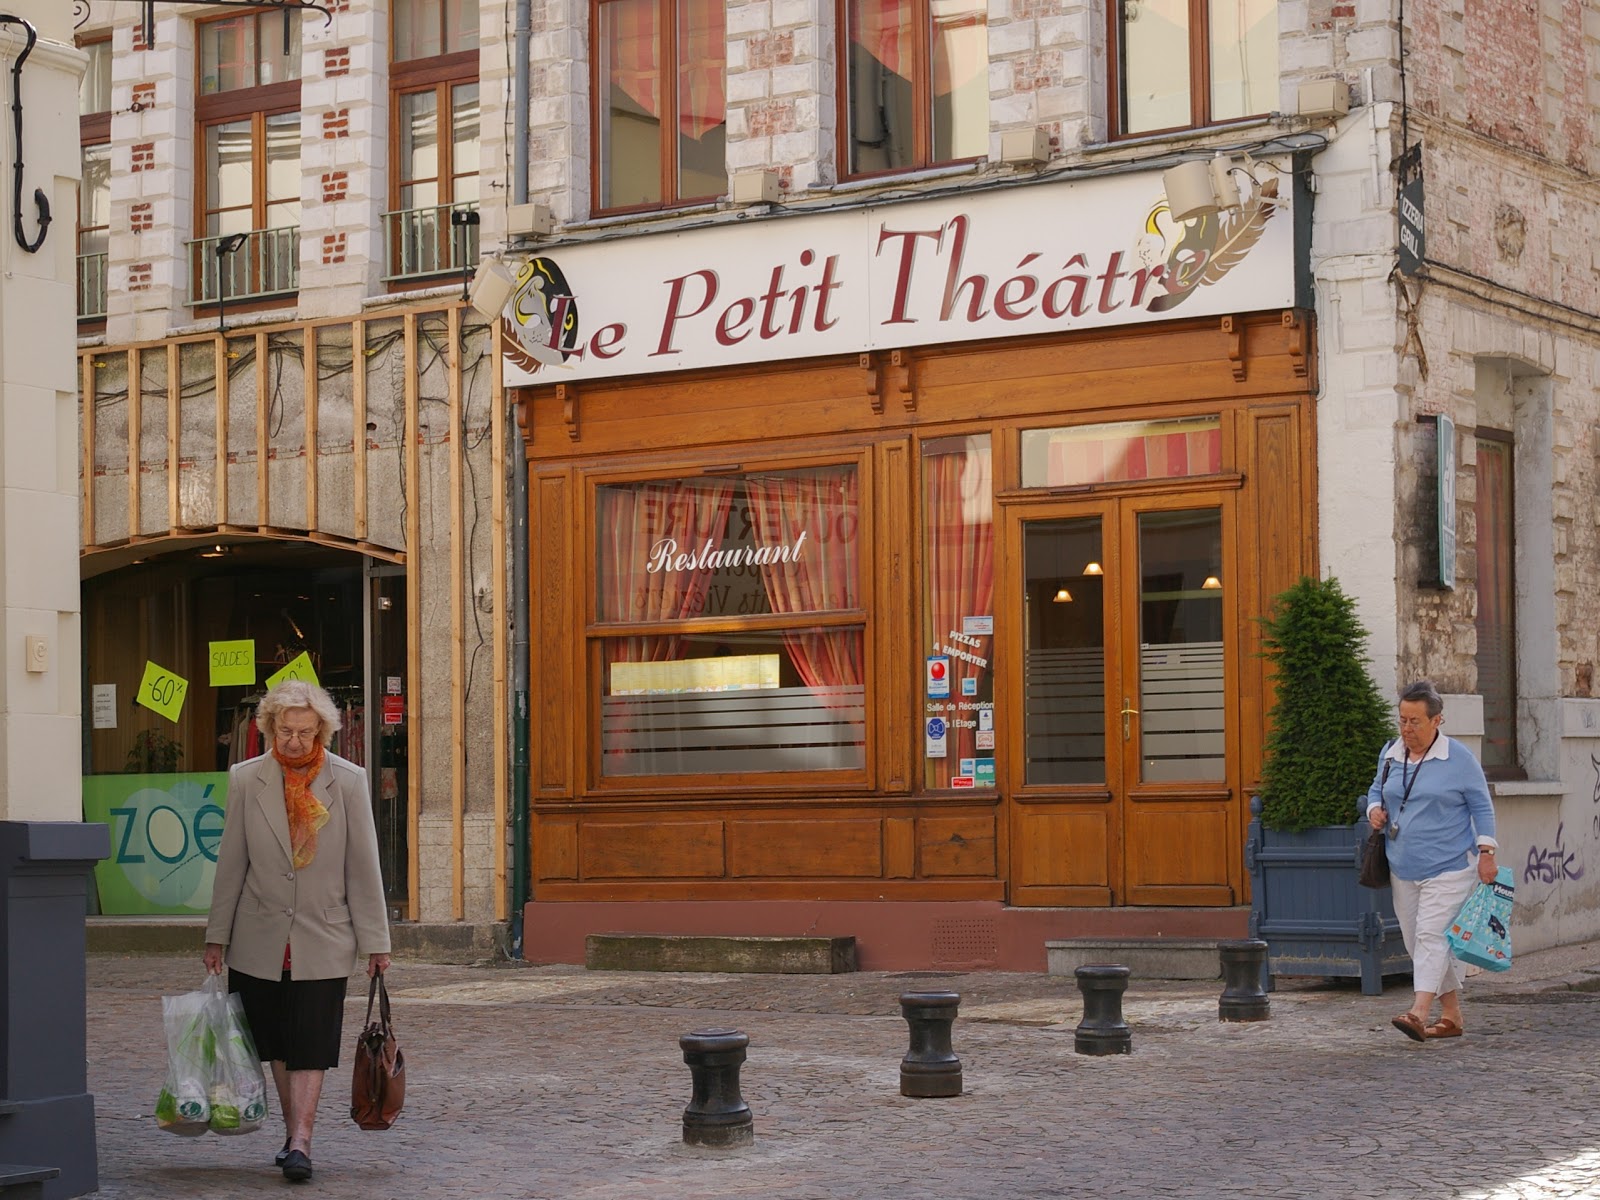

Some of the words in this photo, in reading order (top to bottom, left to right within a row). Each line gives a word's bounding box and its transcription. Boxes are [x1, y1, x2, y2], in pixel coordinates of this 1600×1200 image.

[1400, 193, 1424, 235] IZZERIA
[1400, 224, 1419, 260] GRILL
[543, 294, 628, 362] Le
[648, 249, 844, 358] Petit
[876, 214, 1210, 324] Théâtre
[646, 530, 807, 574] Restaurant
[949, 630, 982, 649] PIZZAS
[211, 651, 250, 667] SOLDES
[942, 645, 988, 669] EMPORTER
[926, 702, 944, 712] Salle
[946, 702, 956, 711] de
[958, 701, 994, 711] Réception
[1494, 885, 1514, 898] Hous
